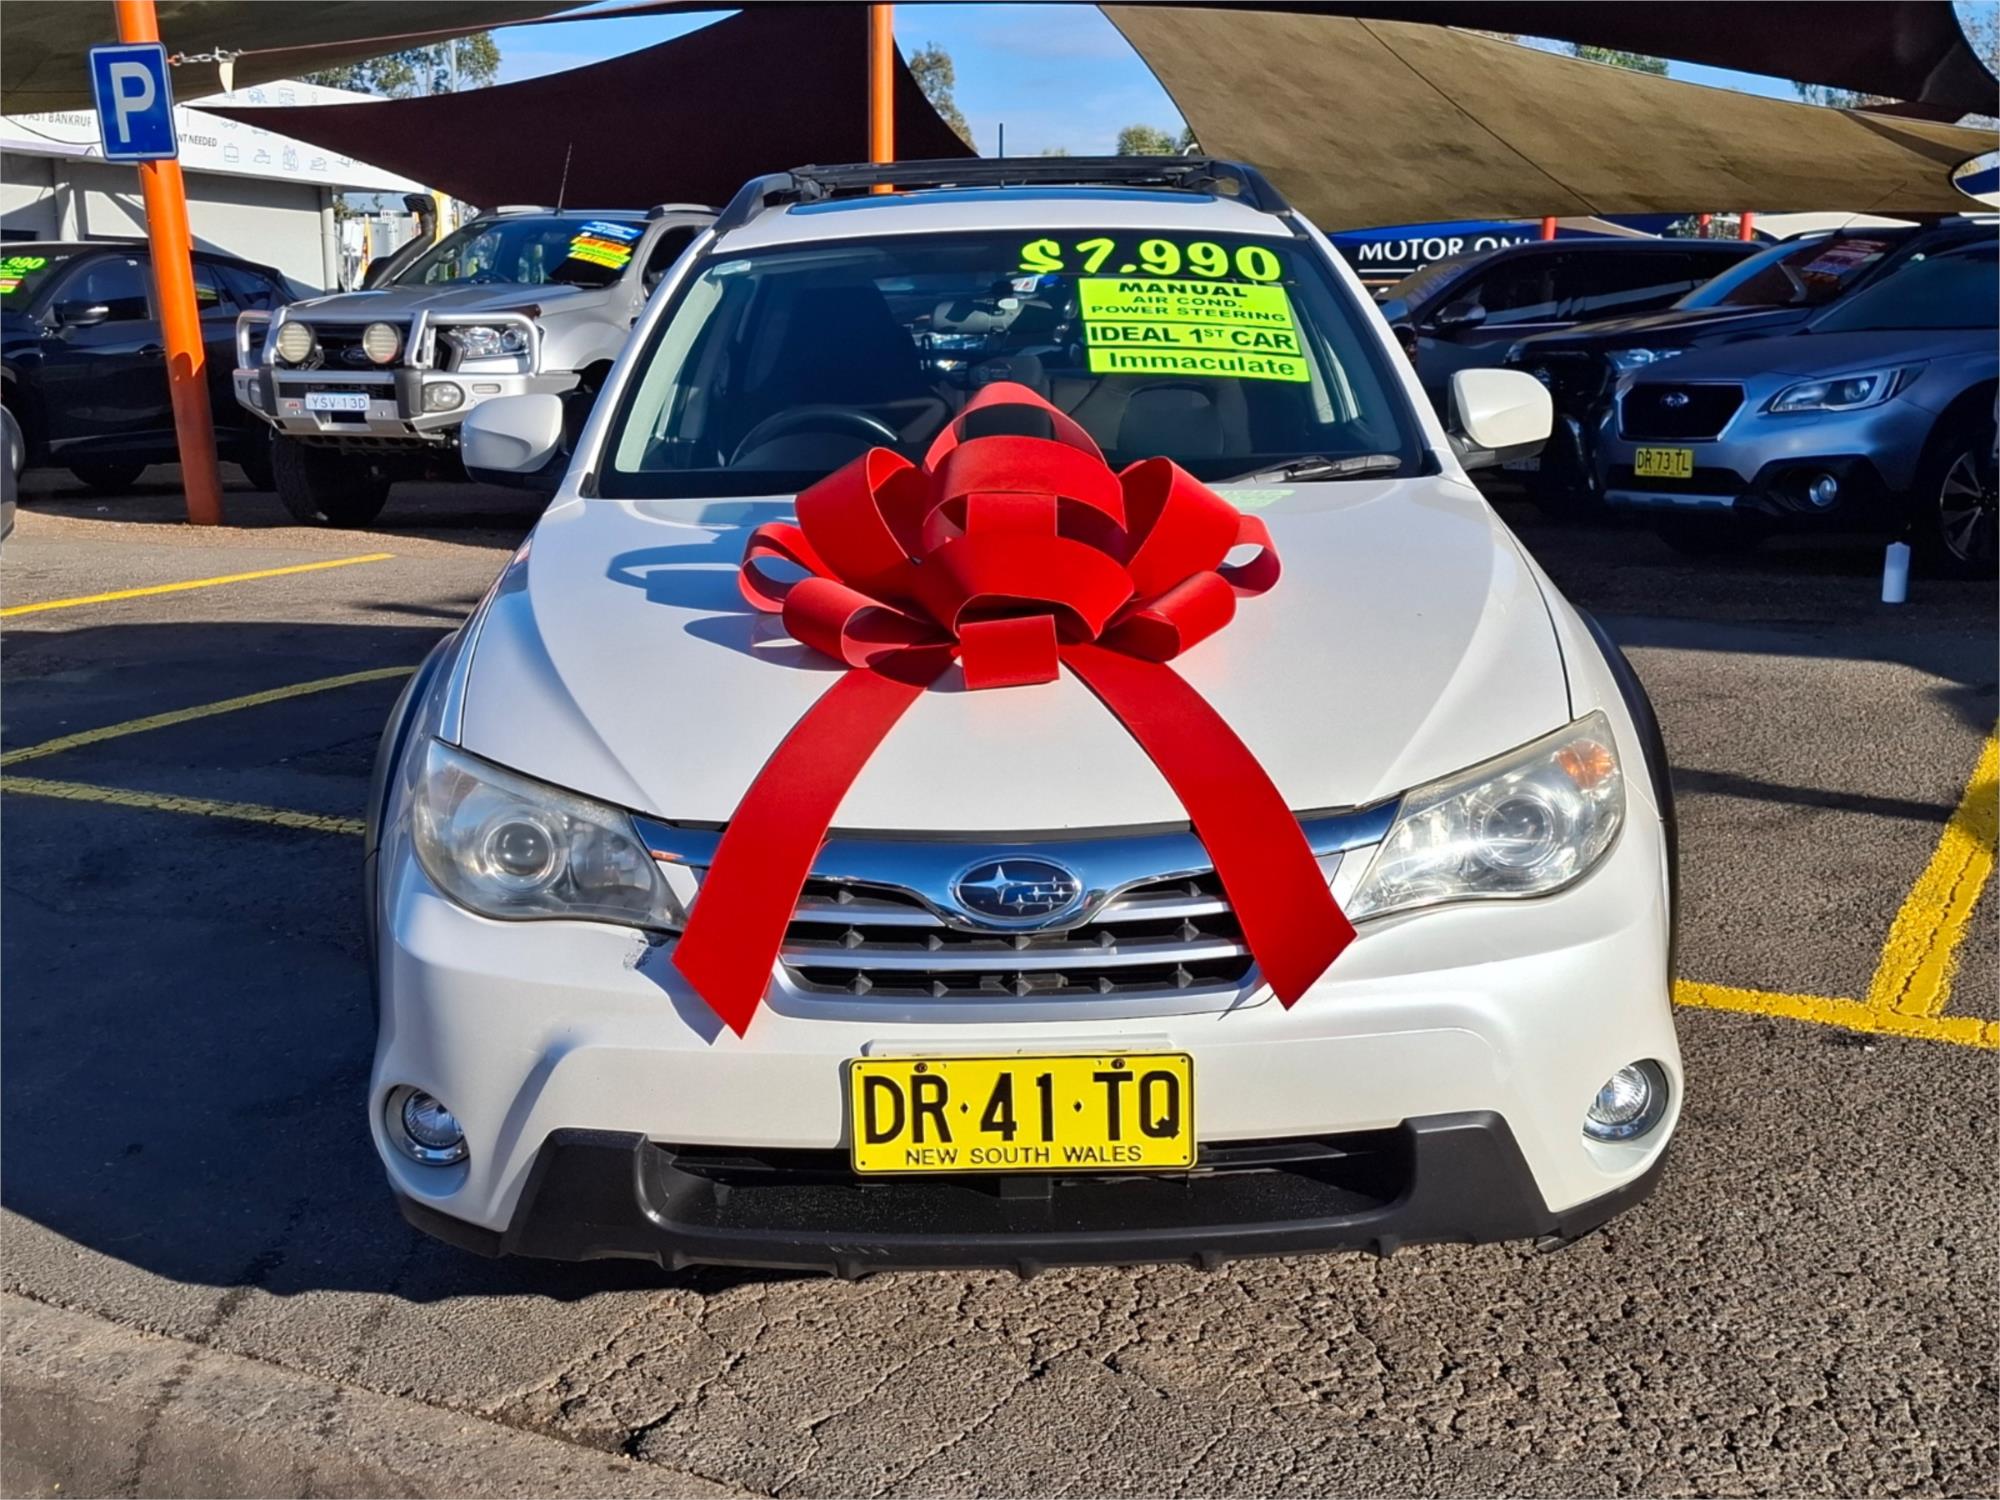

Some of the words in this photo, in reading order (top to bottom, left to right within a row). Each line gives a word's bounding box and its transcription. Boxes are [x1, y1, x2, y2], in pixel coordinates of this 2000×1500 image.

[109, 61, 156, 143] P
[188, 135, 217, 147] NEEDED
[1358, 238, 1464, 261] MOTOR
[1119, 282, 1248, 298] MANUAL
[1133, 295, 1169, 305] AIR
[1176, 297, 1243, 308] COND.
[1091, 305, 1169, 315] POWER
[1176, 307, 1286, 322] STEERING
[1090, 326, 1181, 343] IDEAL
[1230, 331, 1295, 350] CAR
[1110, 352, 1295, 376] Immaculate
[906, 1149, 958, 1165] NEW
[970, 1147, 1049, 1164] SOUTH
[1062, 1145, 1142, 1162] WALES
